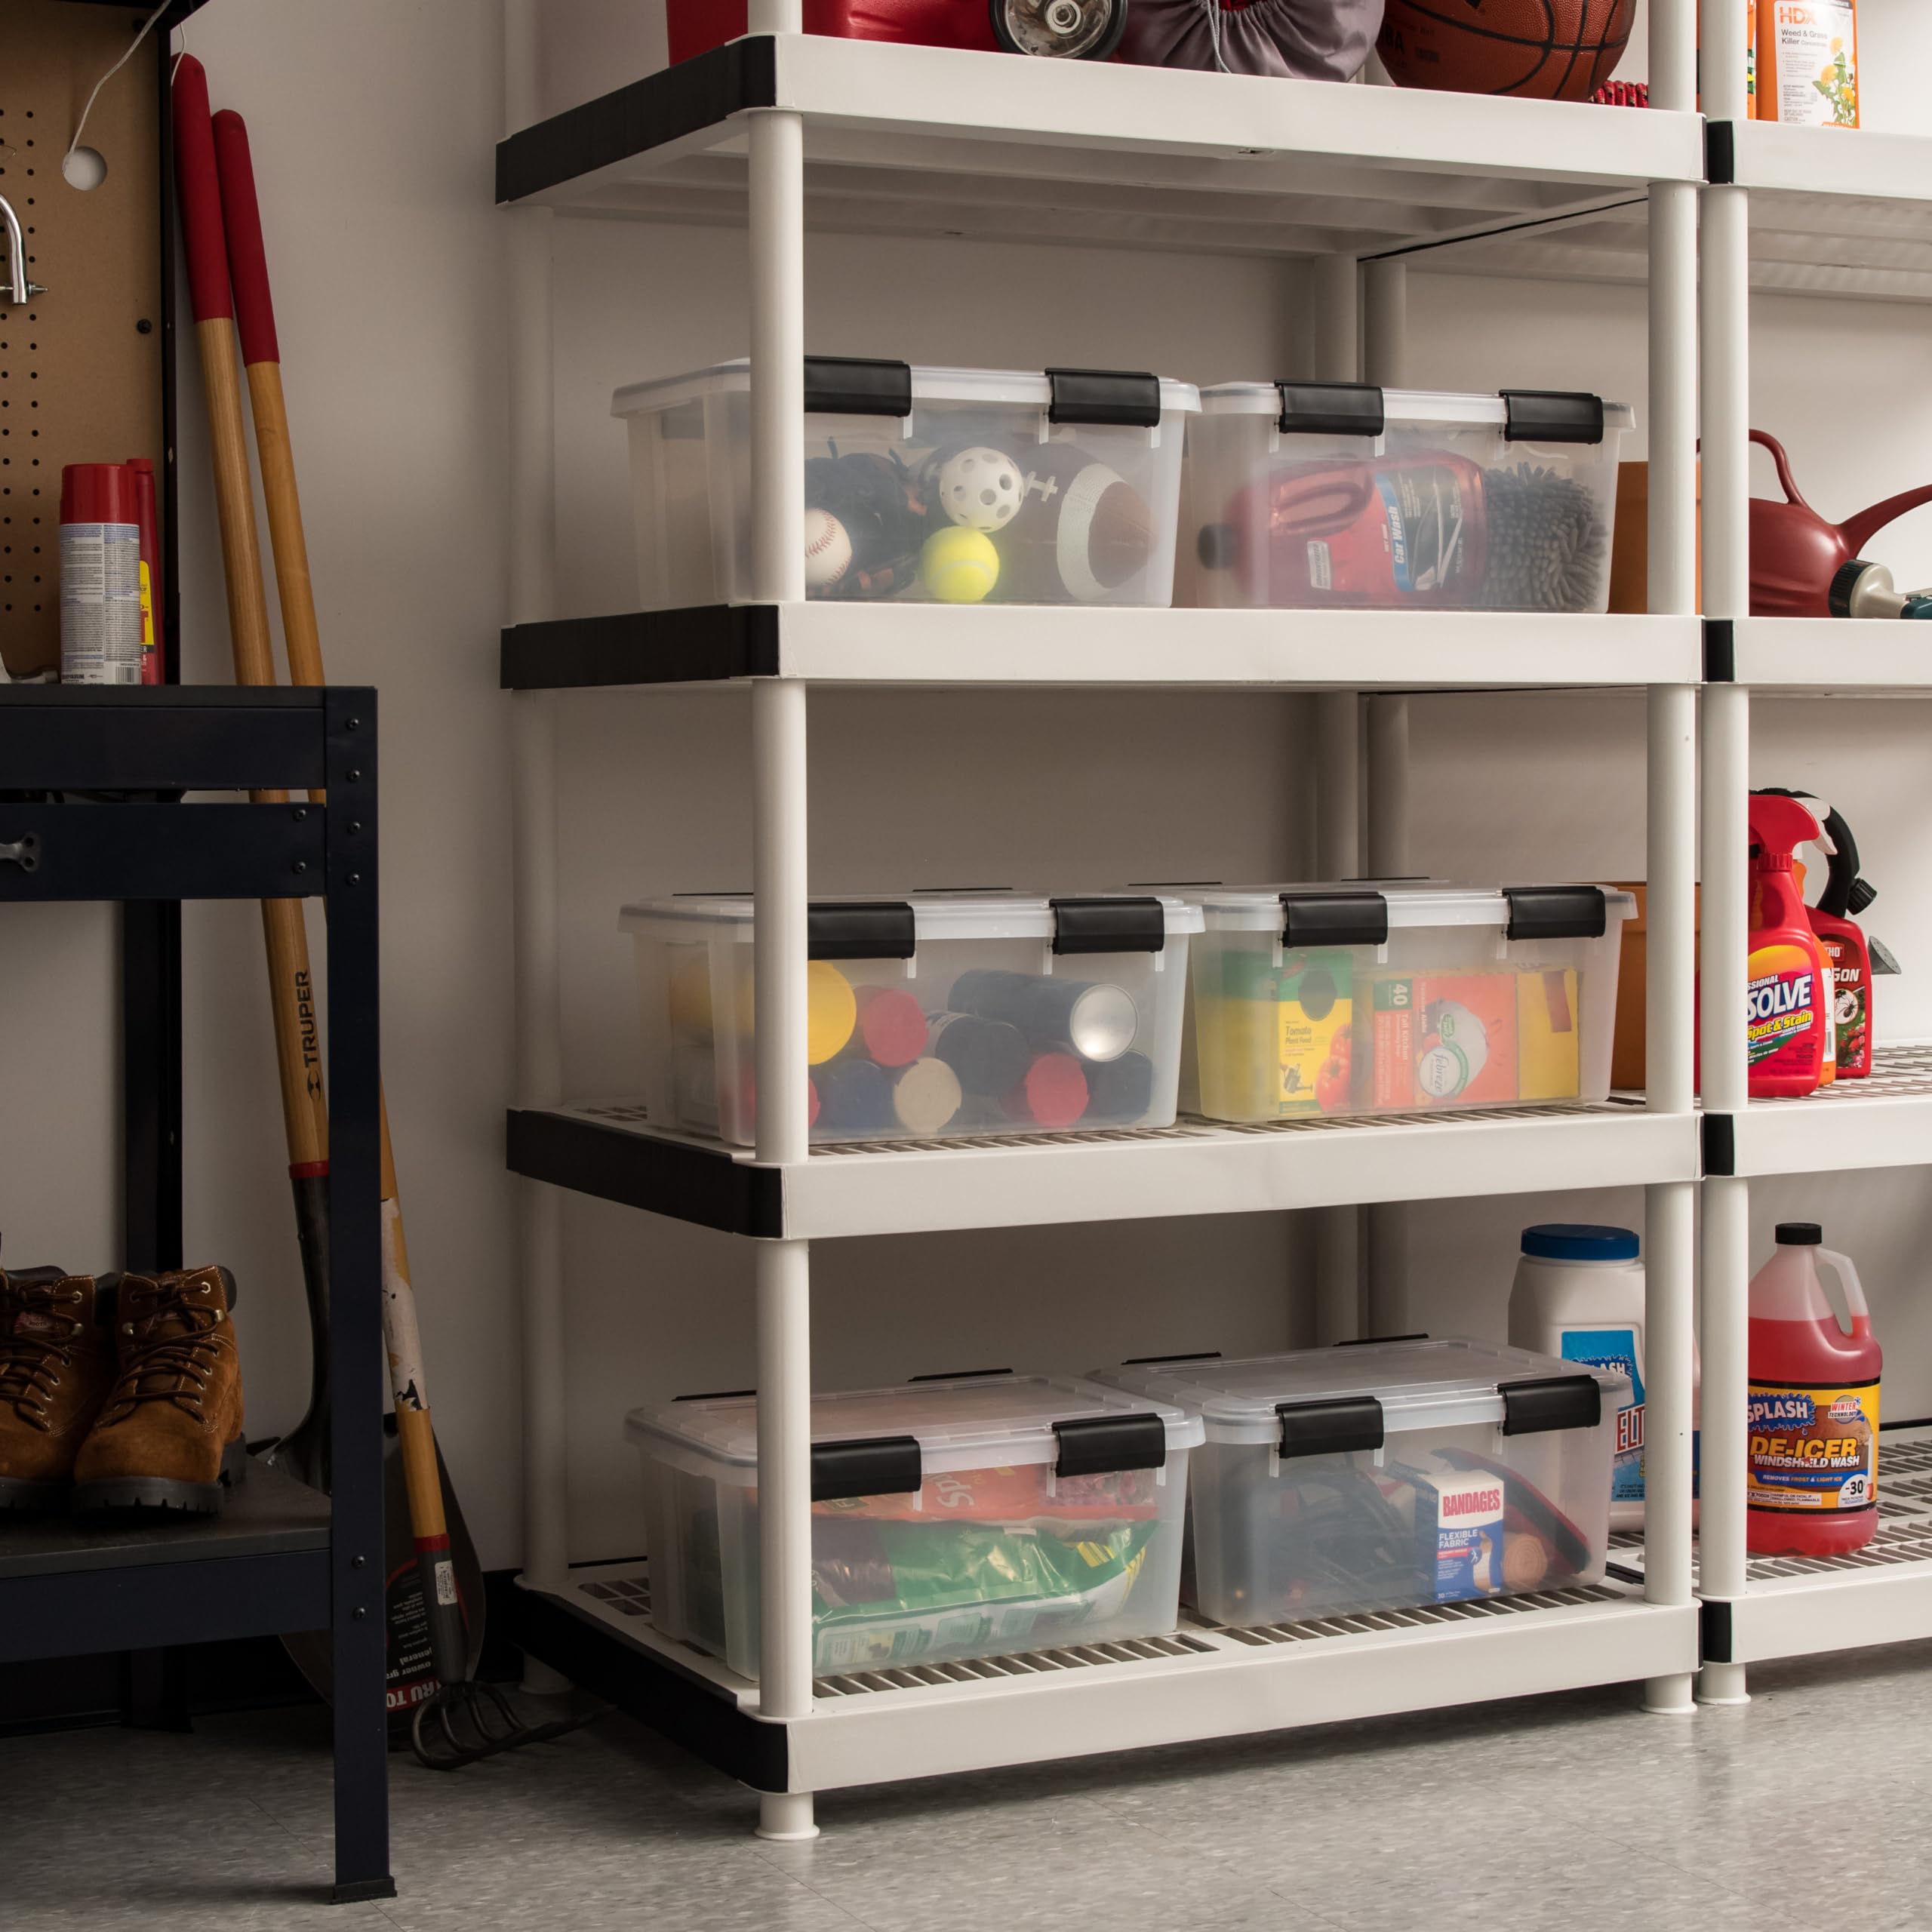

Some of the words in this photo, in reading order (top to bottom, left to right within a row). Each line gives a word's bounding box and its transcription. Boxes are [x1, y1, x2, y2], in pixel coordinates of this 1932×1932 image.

[1780, 6, 1817, 24] HDX
[1781, 29, 1801, 37] Weed
[1388, 506, 1403, 541] Wash
[1395, 543, 1404, 564] Car
[1748, 974, 1779, 990] SSIONAL
[1393, 983, 1408, 1006] 40
[1748, 974, 1811, 1021] SOLVE
[295, 970, 318, 1068] TRUPER
[1773, 1019, 1782, 1032] &
[1782, 1011, 1812, 1029] Stain
[1285, 1026, 1312, 1036] Tomato
[1433, 1054, 1450, 1093] febreze
[1748, 1400, 1808, 1424] SPLASH
[1831, 1401, 1857, 1411] WINTER
[1617, 1405, 1645, 1452] ELT
[1749, 1435, 1858, 1458] DE-ICER
[1830, 1455, 1860, 1468] WASH
[1845, 1479, 1863, 1495] -30
[1442, 1488, 1501, 1518] BANDAGES
[1438, 1529, 1478, 1541] FLEXIBLE
[1438, 1538, 1469, 1549] FABRIC
